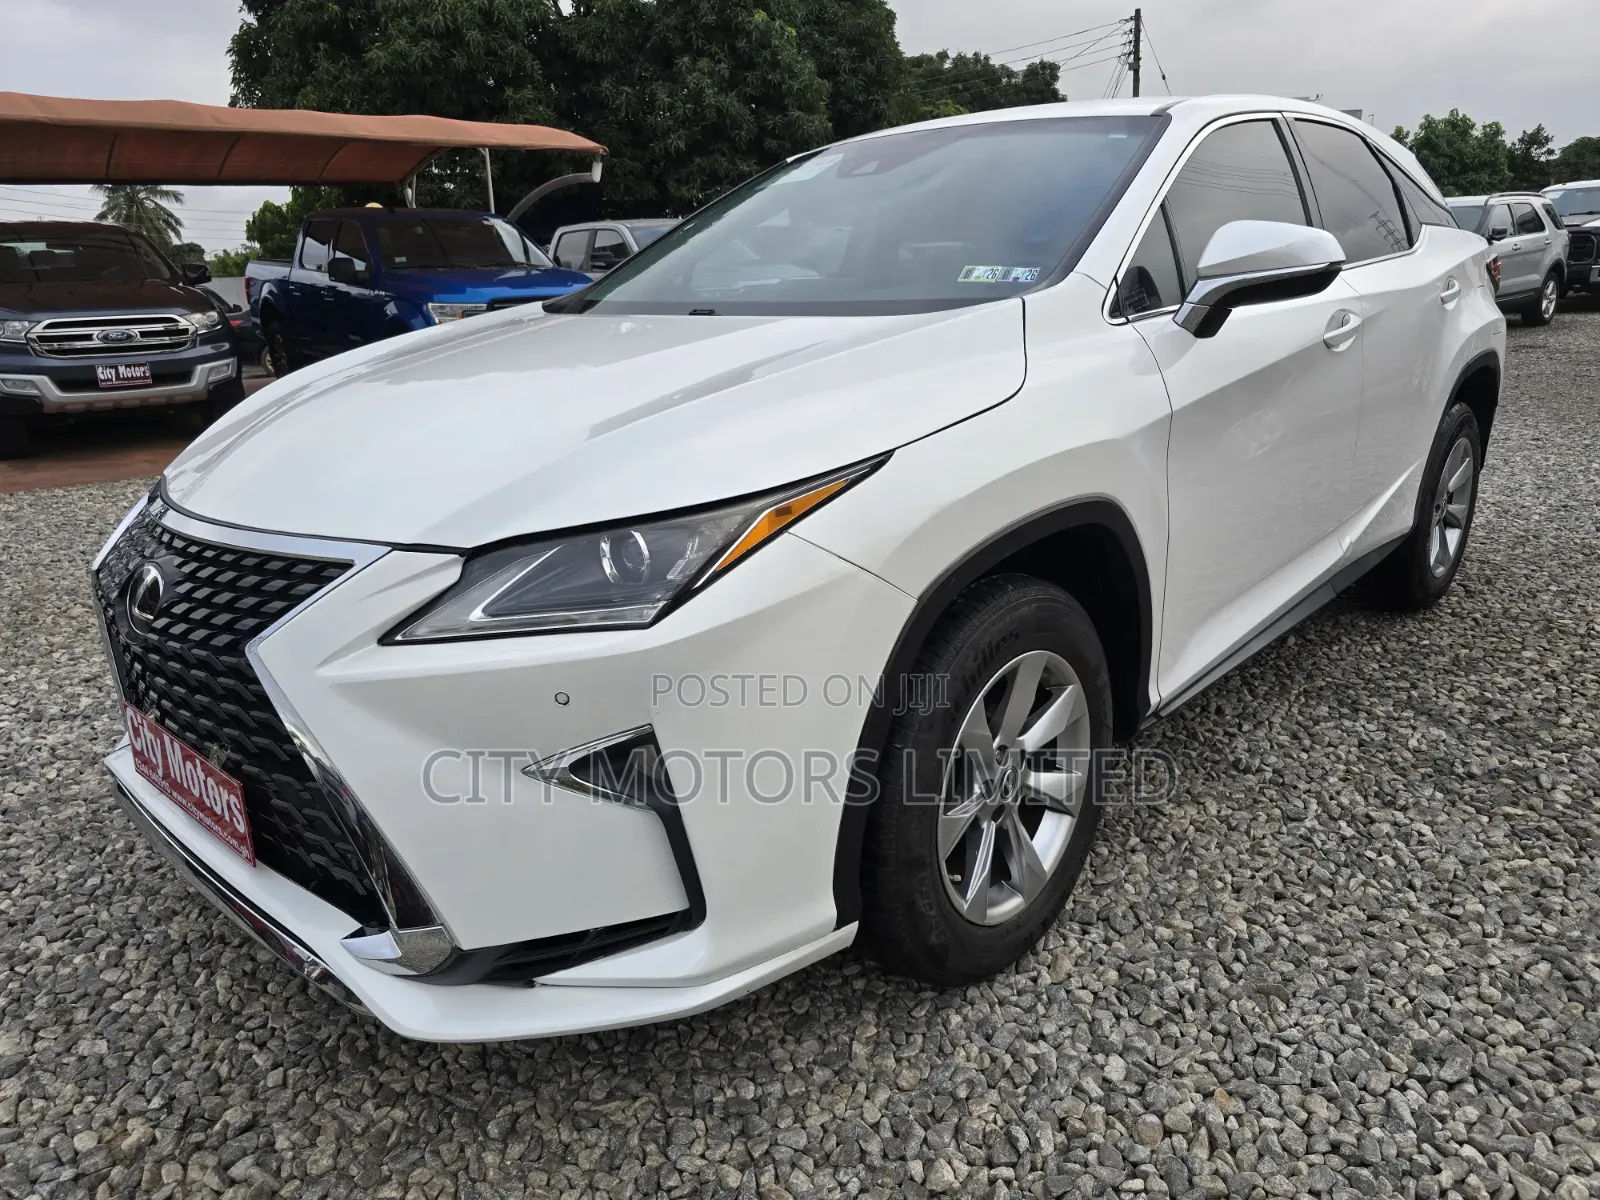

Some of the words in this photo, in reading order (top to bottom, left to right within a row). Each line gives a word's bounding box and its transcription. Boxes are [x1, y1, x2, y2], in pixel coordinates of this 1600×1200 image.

[986, 268, 1000, 280] 26
[1024, 269, 1038, 281] 26
[108, 332, 127, 340] Ford
[97, 366, 116, 382] City
[117, 364, 150, 379] Motors
[126, 706, 163, 778] City
[162, 732, 246, 834] Motors
